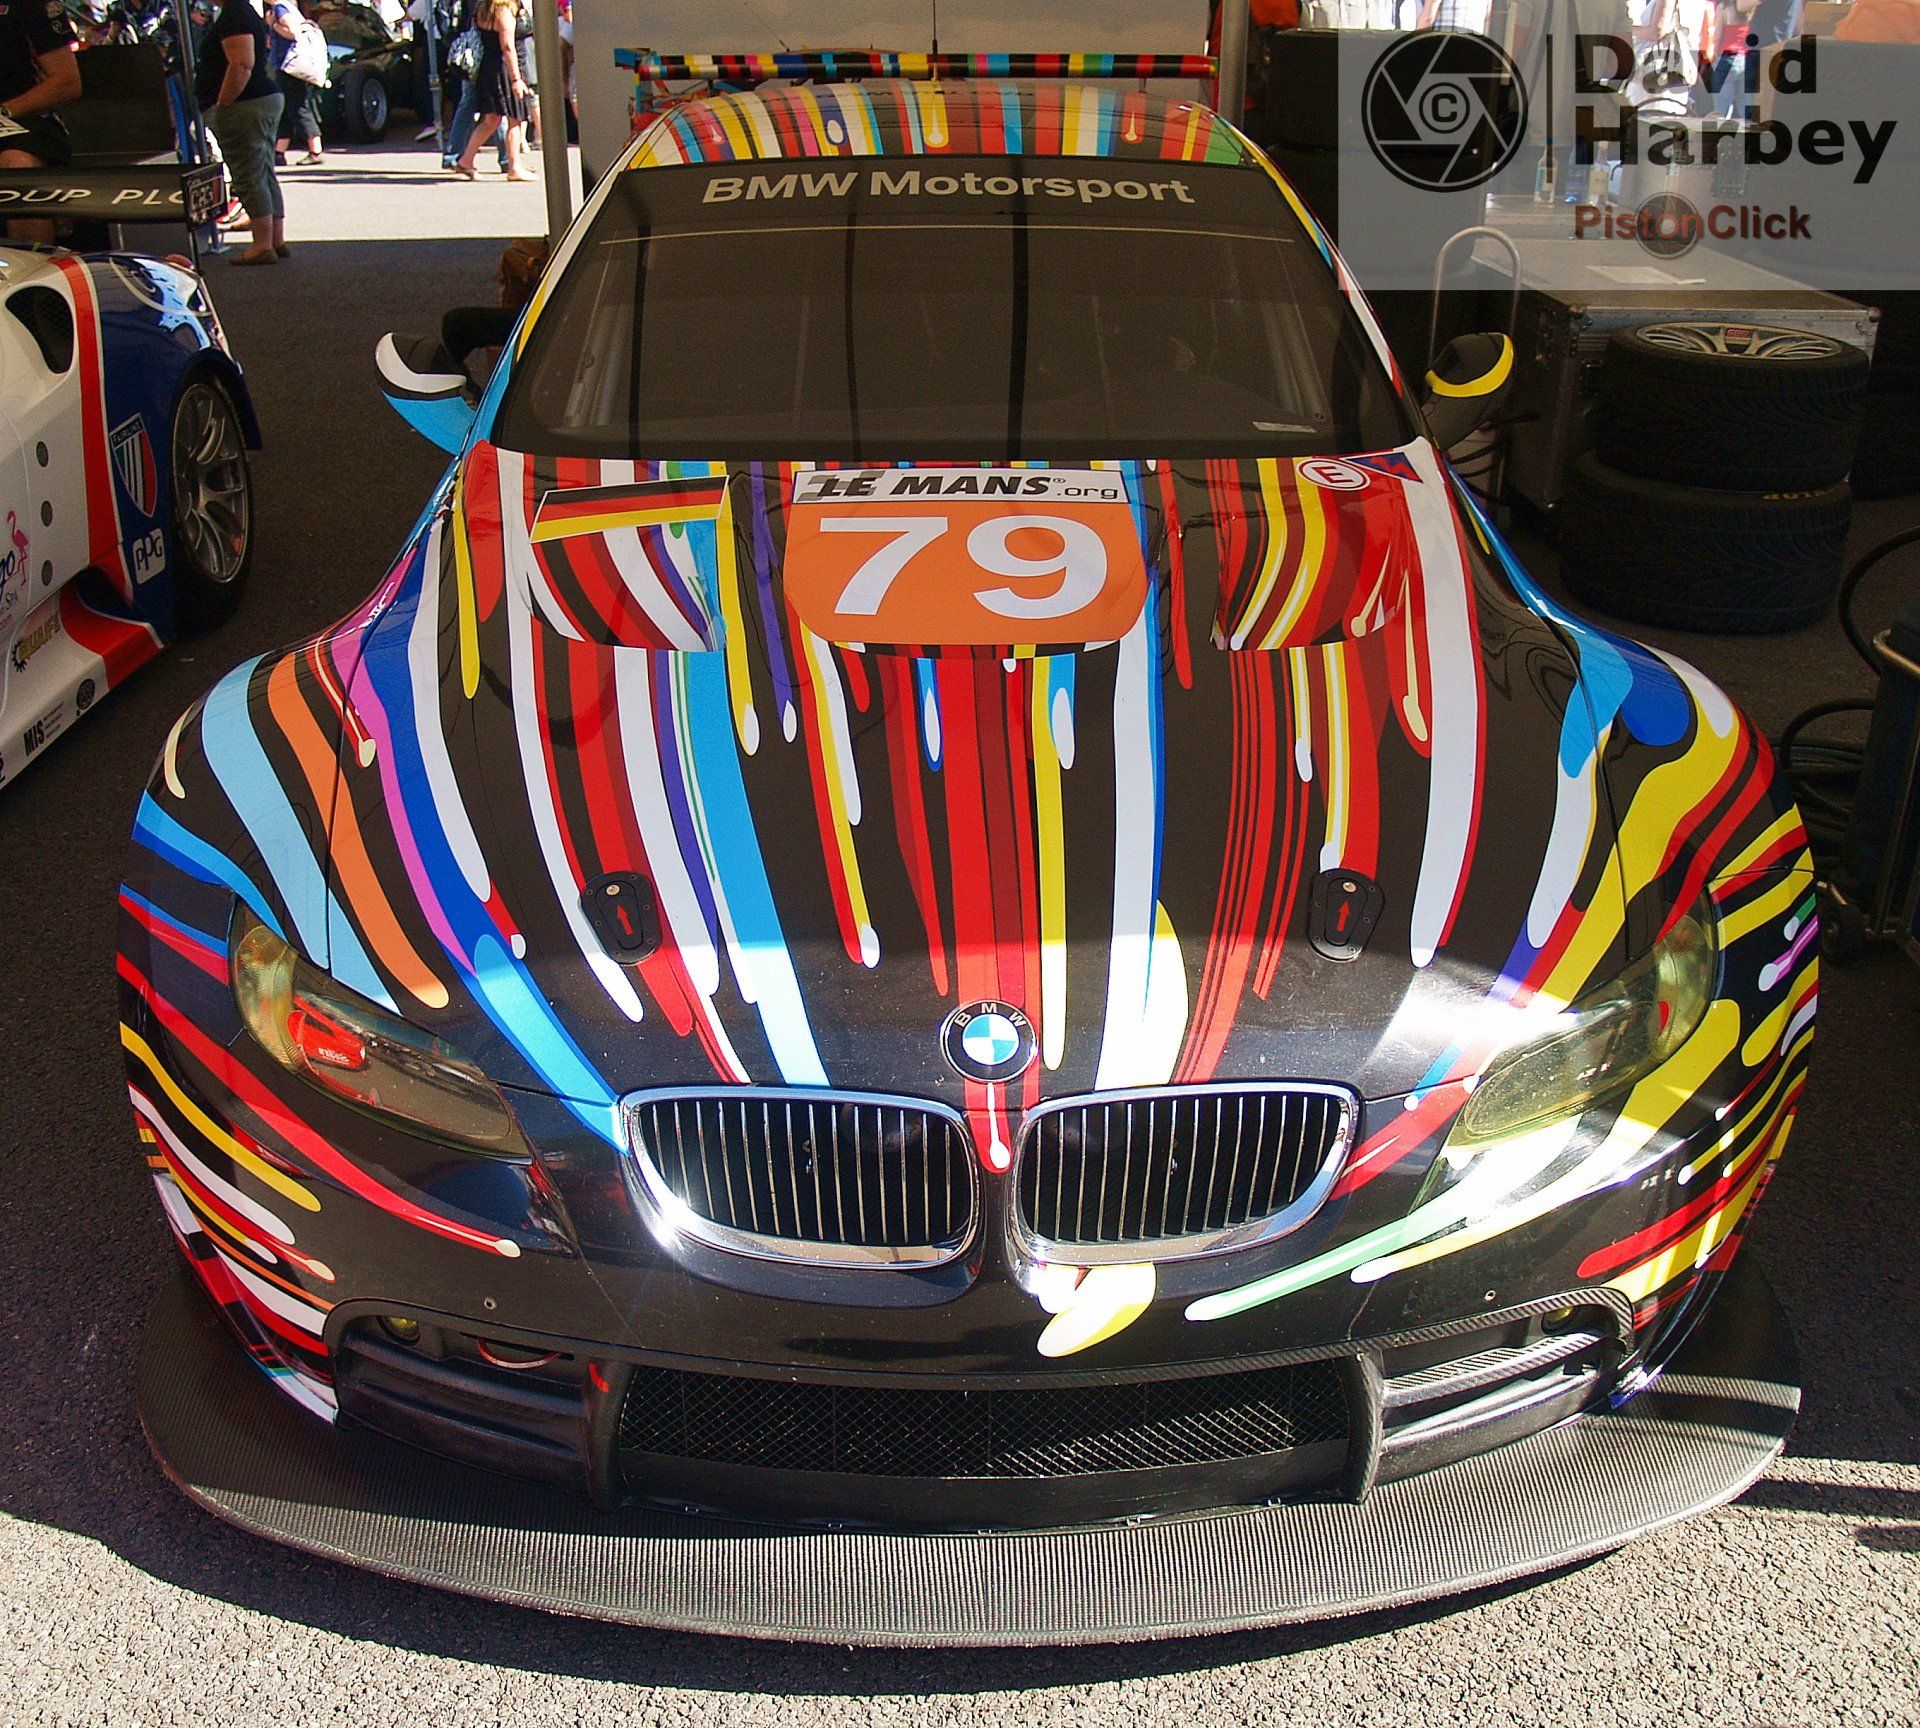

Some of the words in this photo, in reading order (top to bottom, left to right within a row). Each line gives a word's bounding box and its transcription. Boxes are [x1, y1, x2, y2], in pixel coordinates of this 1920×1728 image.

[702, 172, 858, 203] BMW
[870, 170, 1196, 203] Motorsport
[817, 476, 877, 497] LE
[1057, 487, 1118, 499] .org
[819, 514, 1108, 619] 79
[24, 719, 45, 757] MIS
[954, 1002, 1027, 1028] BMW
